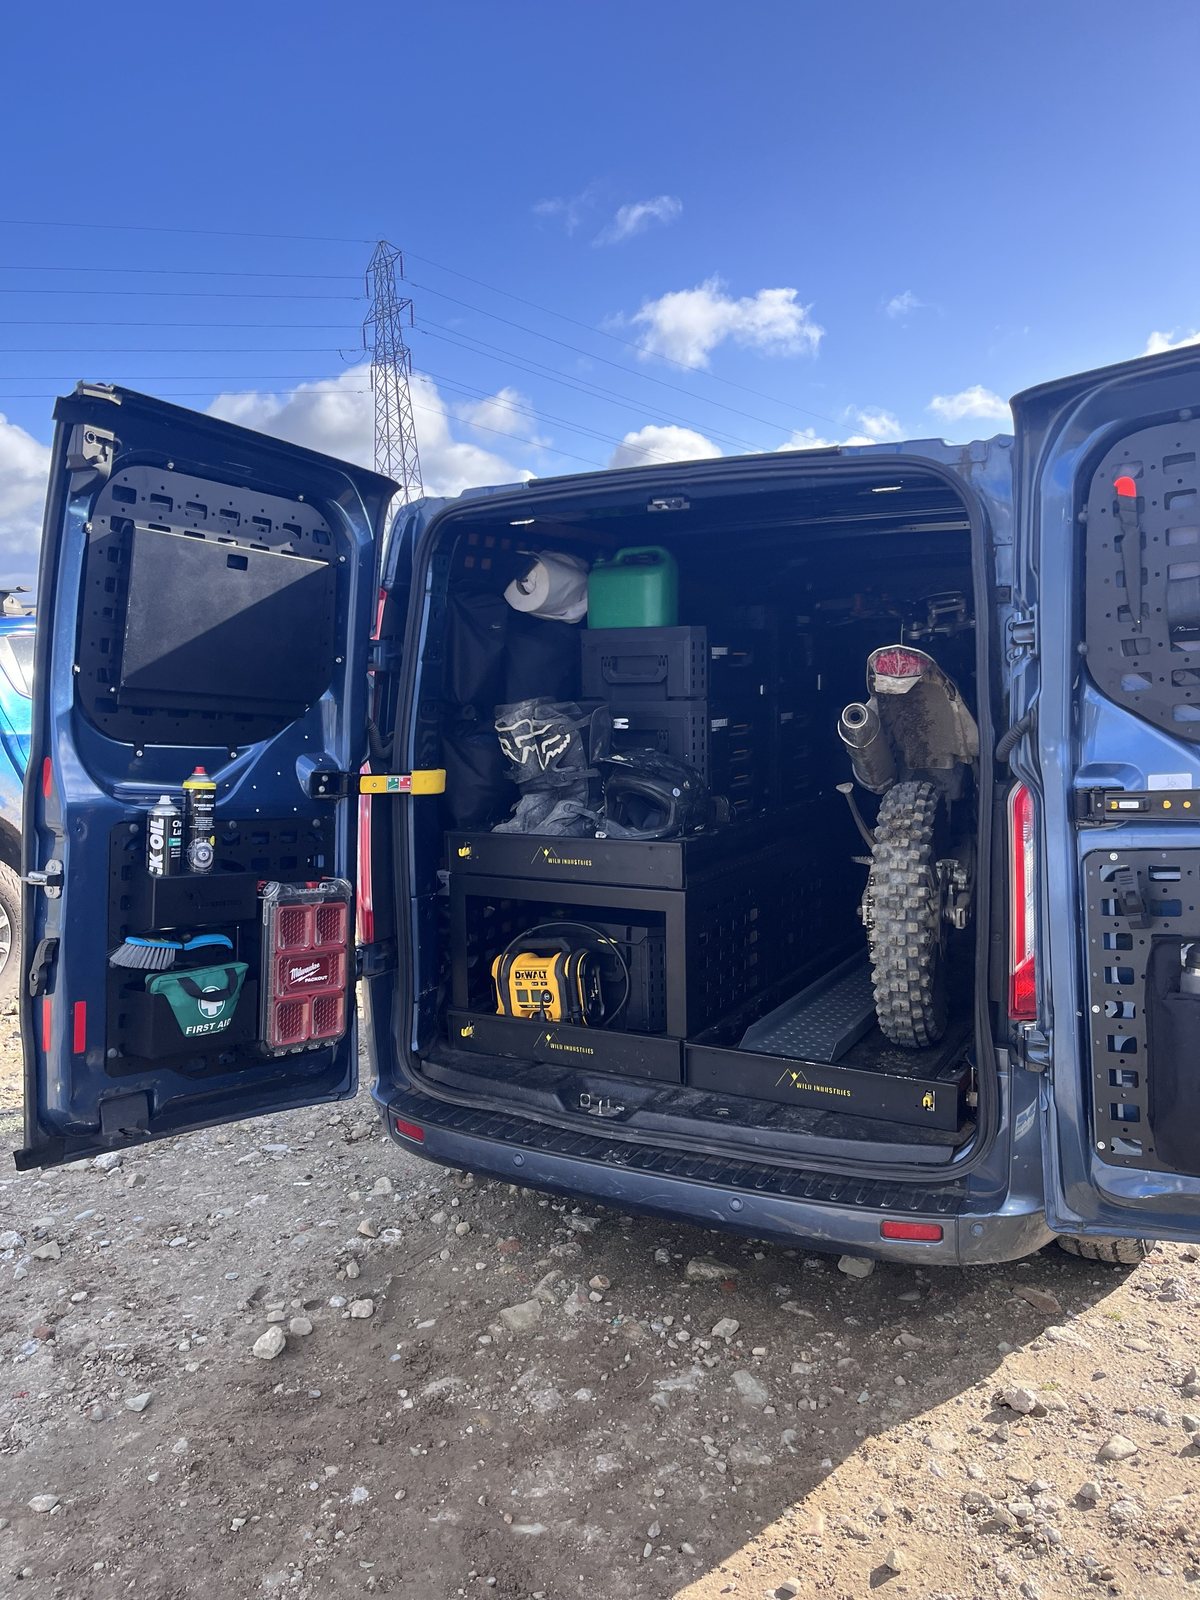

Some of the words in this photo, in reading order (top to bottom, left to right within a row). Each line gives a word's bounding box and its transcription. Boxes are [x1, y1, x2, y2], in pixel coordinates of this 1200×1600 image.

[149, 818, 165, 850] OIL
[561, 858, 592, 866] INDUSTRIES
[289, 962, 321, 981] Milwaukee
[304, 975, 328, 983] PACKOUT
[185, 1022, 216, 1035] FIRST
[217, 1017, 232, 1029] AID
[550, 1042, 563, 1050] WILD
[563, 1044, 594, 1055] INDUSTRIES
[796, 1082, 812, 1091] WILD
[813, 1084, 851, 1097] INDUSTRIES
